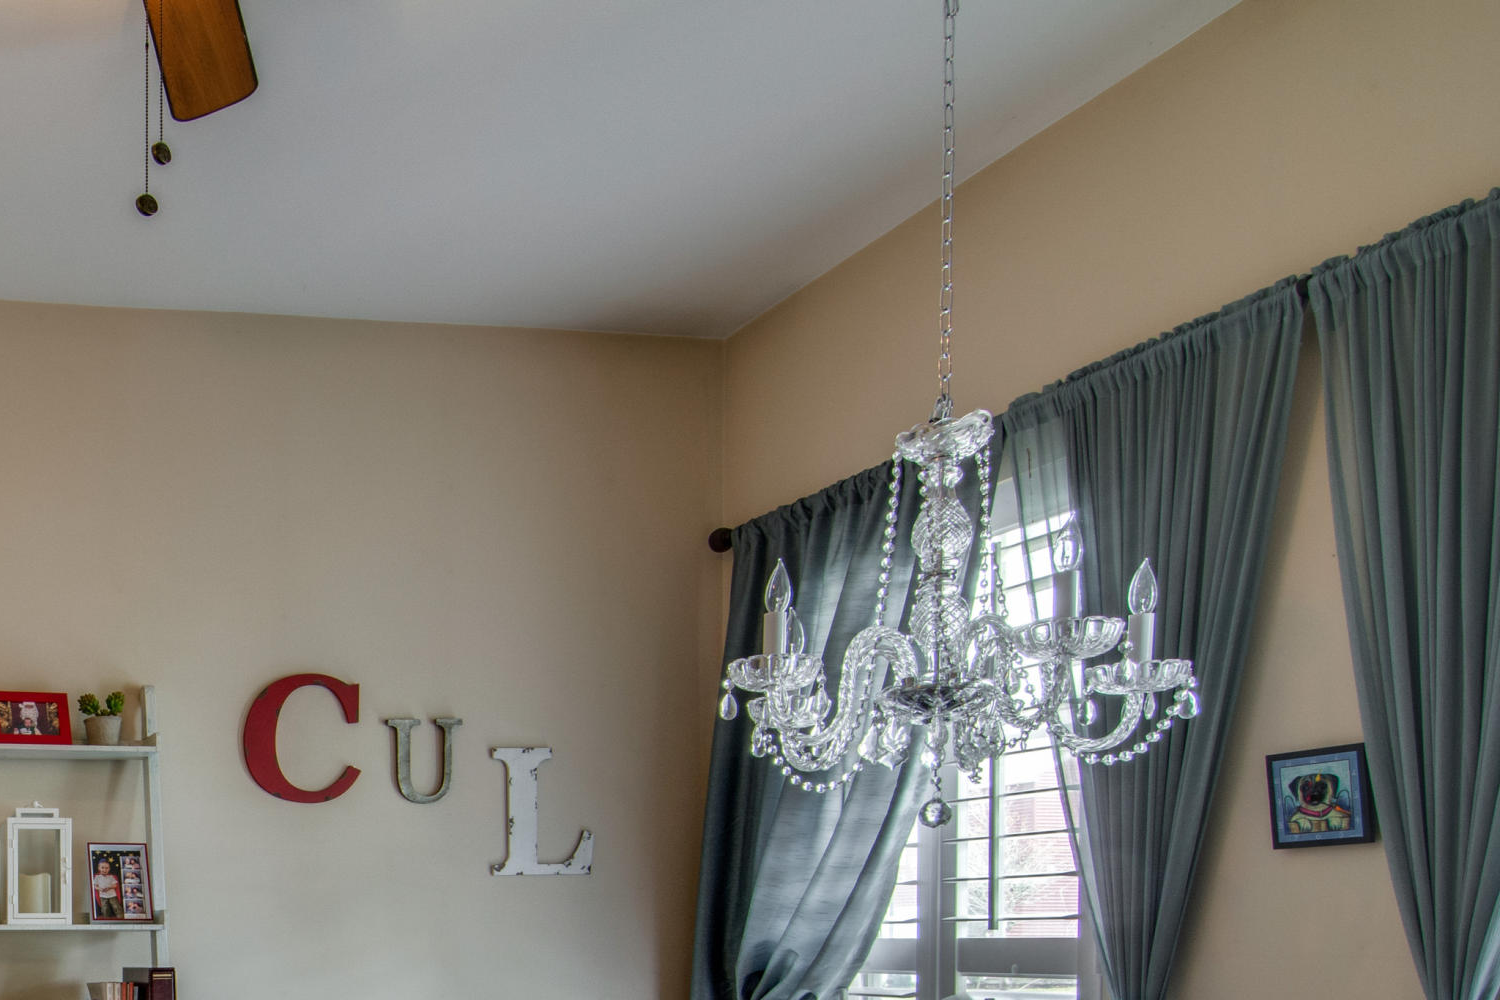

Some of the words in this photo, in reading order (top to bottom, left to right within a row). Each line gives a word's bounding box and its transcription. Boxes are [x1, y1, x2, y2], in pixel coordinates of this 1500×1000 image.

[243, 673, 362, 804] C
[386, 718, 463, 804] U
[490, 746, 595, 876] L
